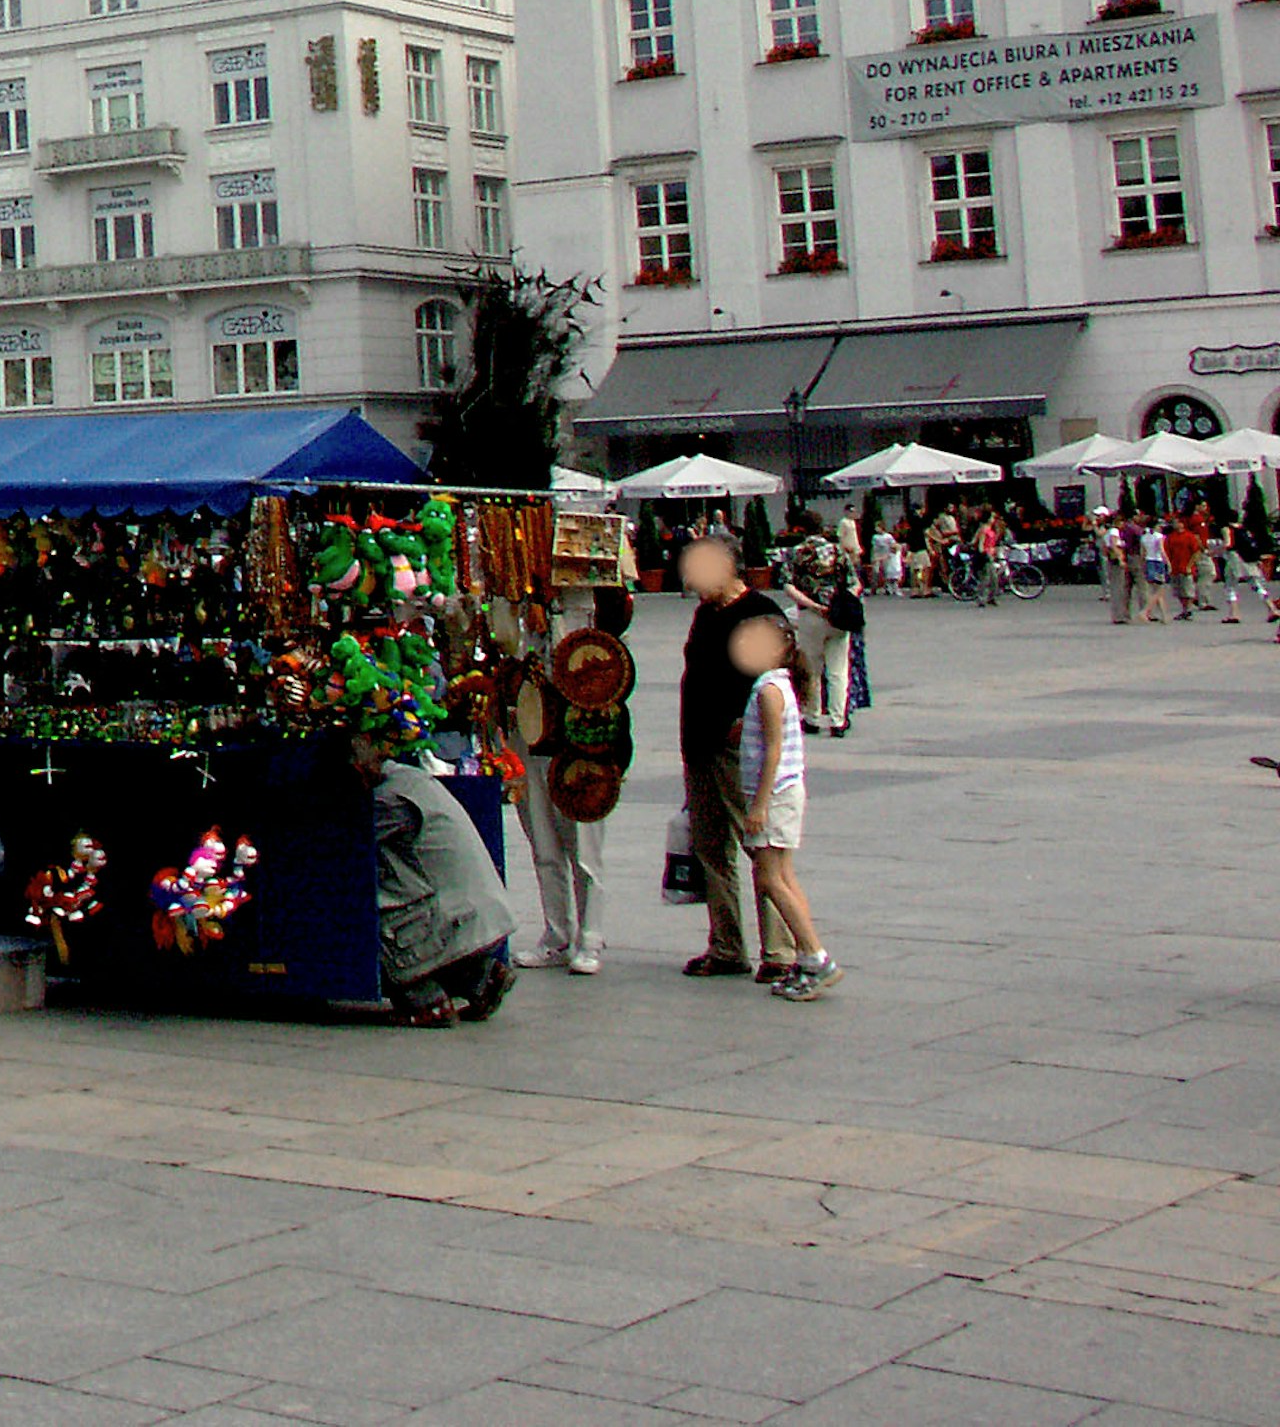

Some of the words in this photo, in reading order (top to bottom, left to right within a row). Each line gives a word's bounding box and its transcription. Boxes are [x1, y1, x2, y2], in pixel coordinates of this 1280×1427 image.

[867, 62, 891, 78] DO
[898, 50, 998, 73] WYNAJĘCIA
[1005, 44, 1059, 63] BIURA
[1066, 41, 1071, 56] I
[1079, 28, 1195, 54] MIESZKANIA
[885, 86, 918, 102] FOR
[924, 80, 966, 98] RENT
[973, 73, 1032, 93] OFFICE
[1039, 71, 1051, 86] &
[1059, 57, 1178, 84] APARTMENTS
[1069, 95, 1092, 109] tel.
[1098, 92, 1122, 106] +12
[1128, 88, 1153, 103] 421
[1159, 86, 1174, 99] 15
[1180, 83, 1199, 98] 25
[869, 115, 887, 129] 50
[901, 111, 927, 126] 270
